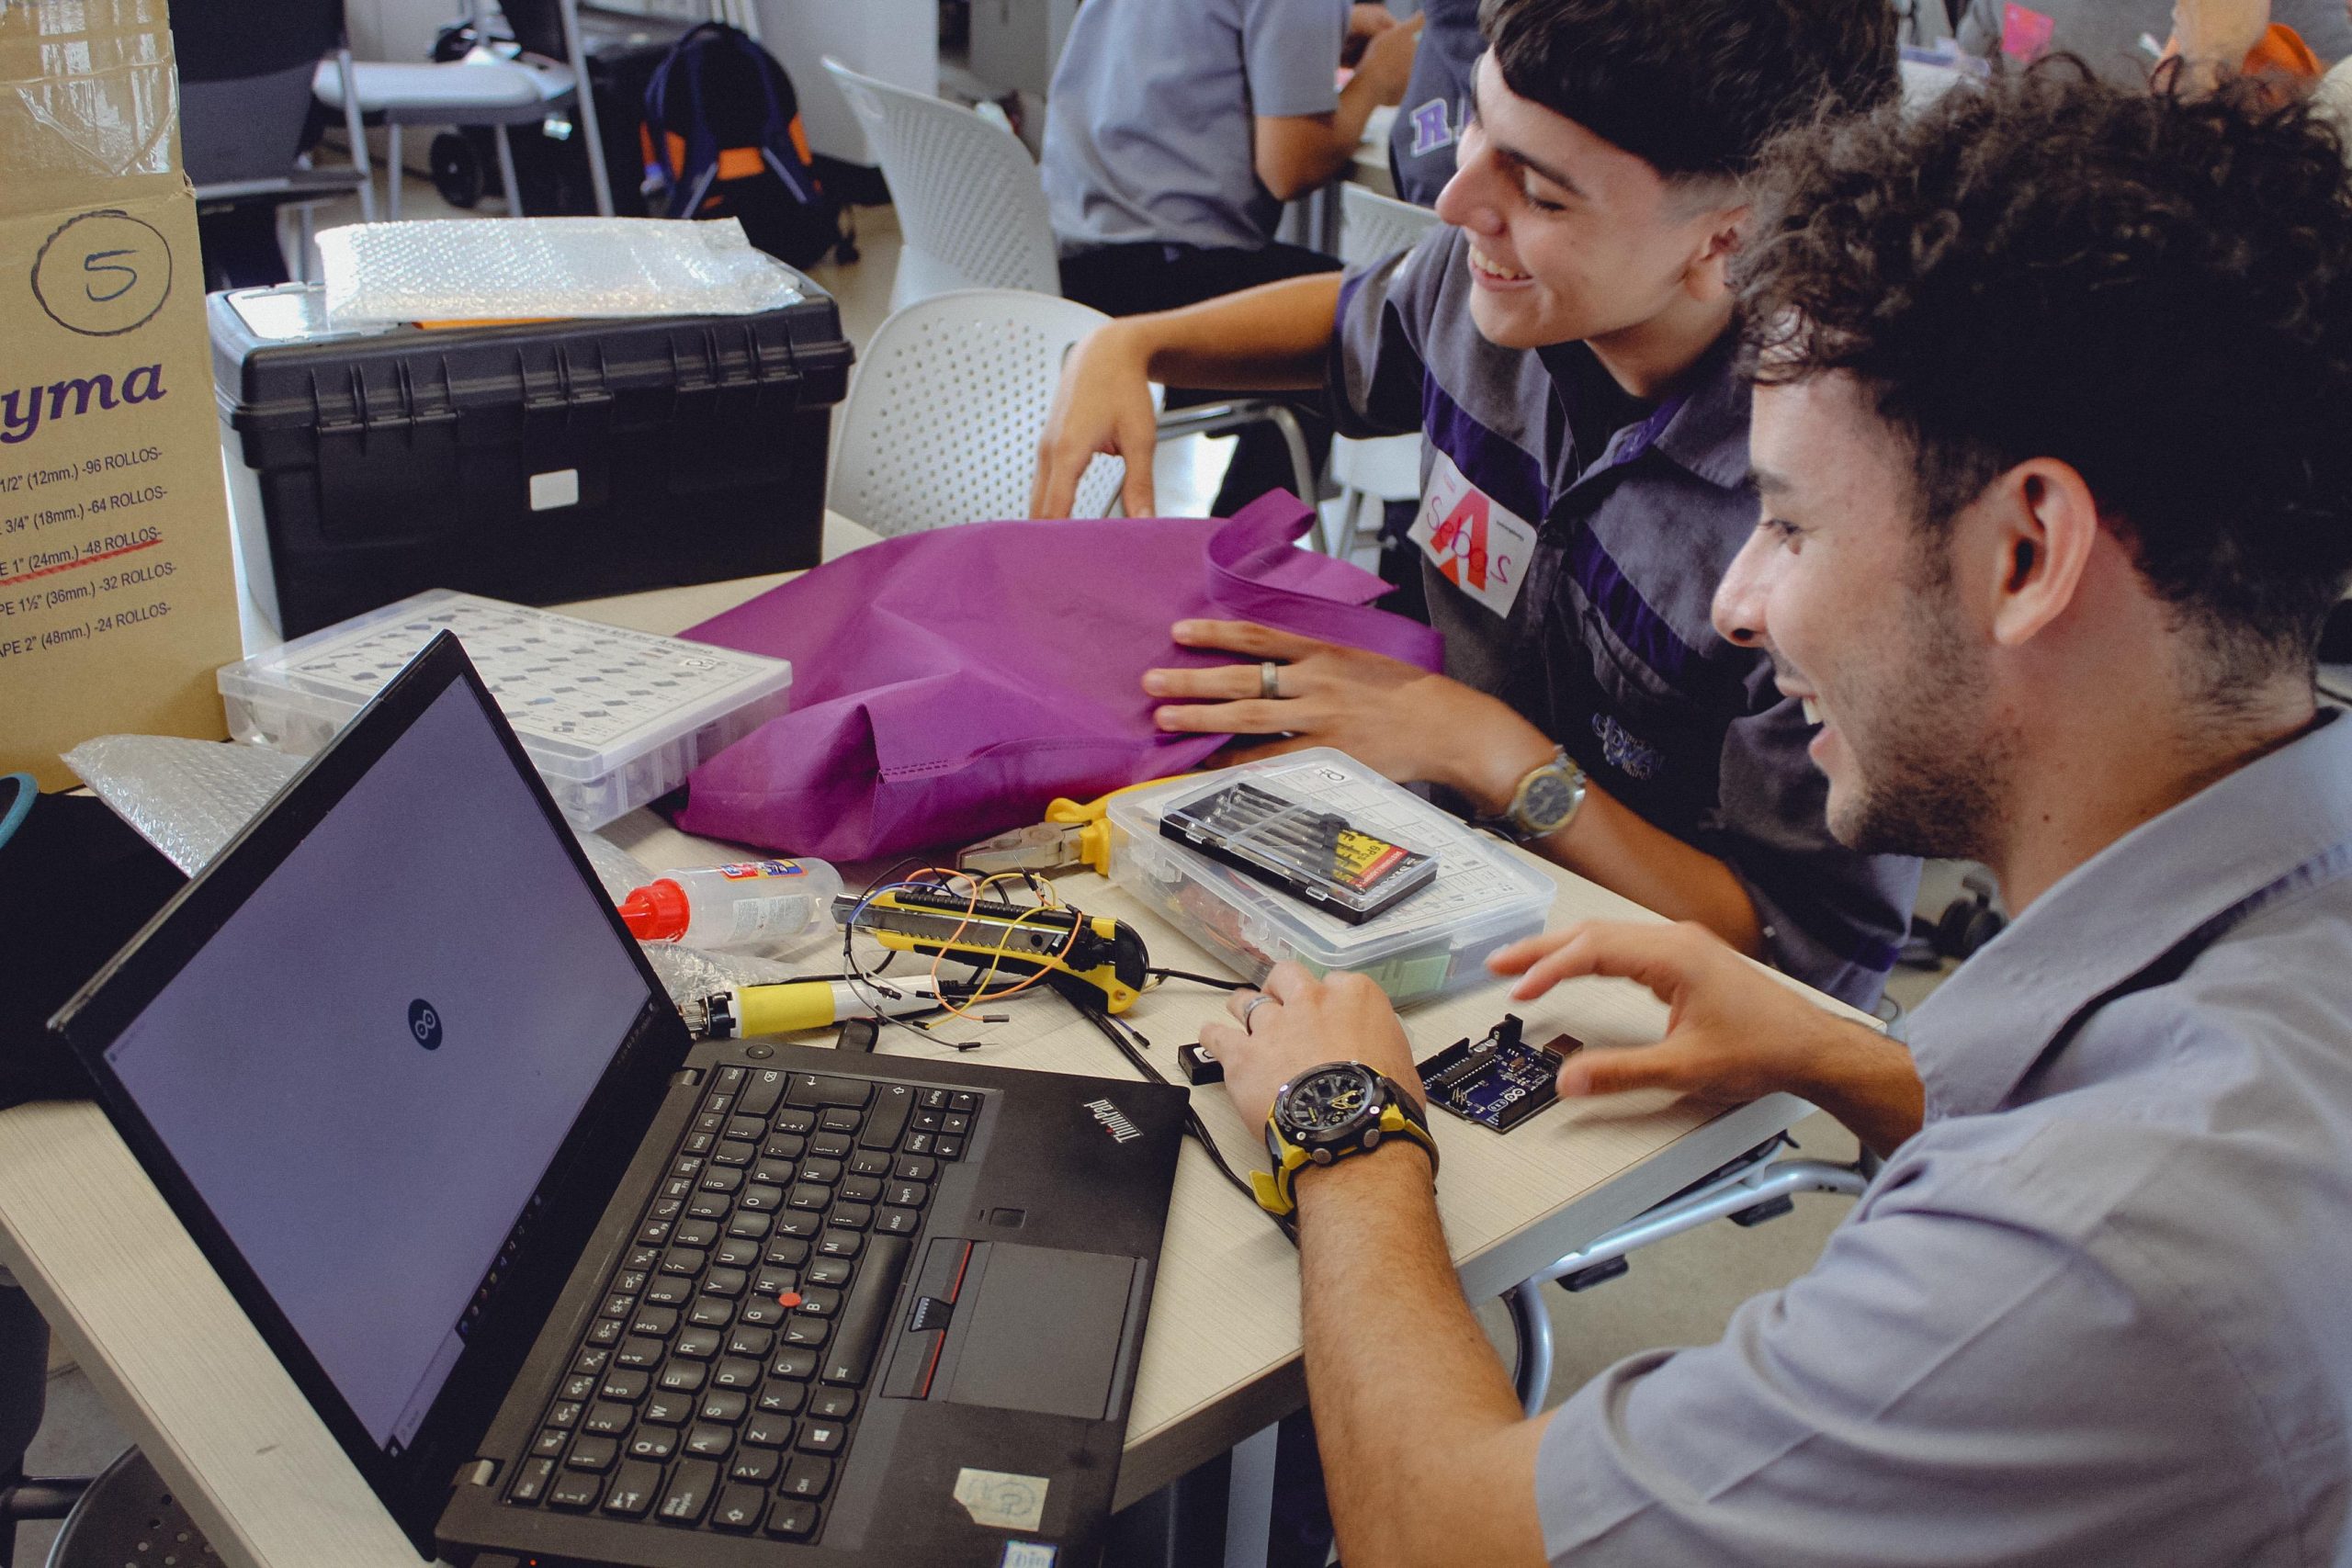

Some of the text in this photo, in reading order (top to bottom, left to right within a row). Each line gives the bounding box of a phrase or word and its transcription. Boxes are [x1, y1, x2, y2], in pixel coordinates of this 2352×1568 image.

[84, 249, 139, 302] 5
[1, 364, 167, 445] yma
[27, 464, 78, 491] (12mm.)
[6, 515, 28, 534] 3/4"
[33, 503, 85, 530] (18mm.)
[28, 546, 79, 573] (24mm.)
[46, 581, 96, 610] (36mm.)
[41, 622, 91, 651] (48mm.)
[1083, 1099, 1142, 1144] ThinkPad
